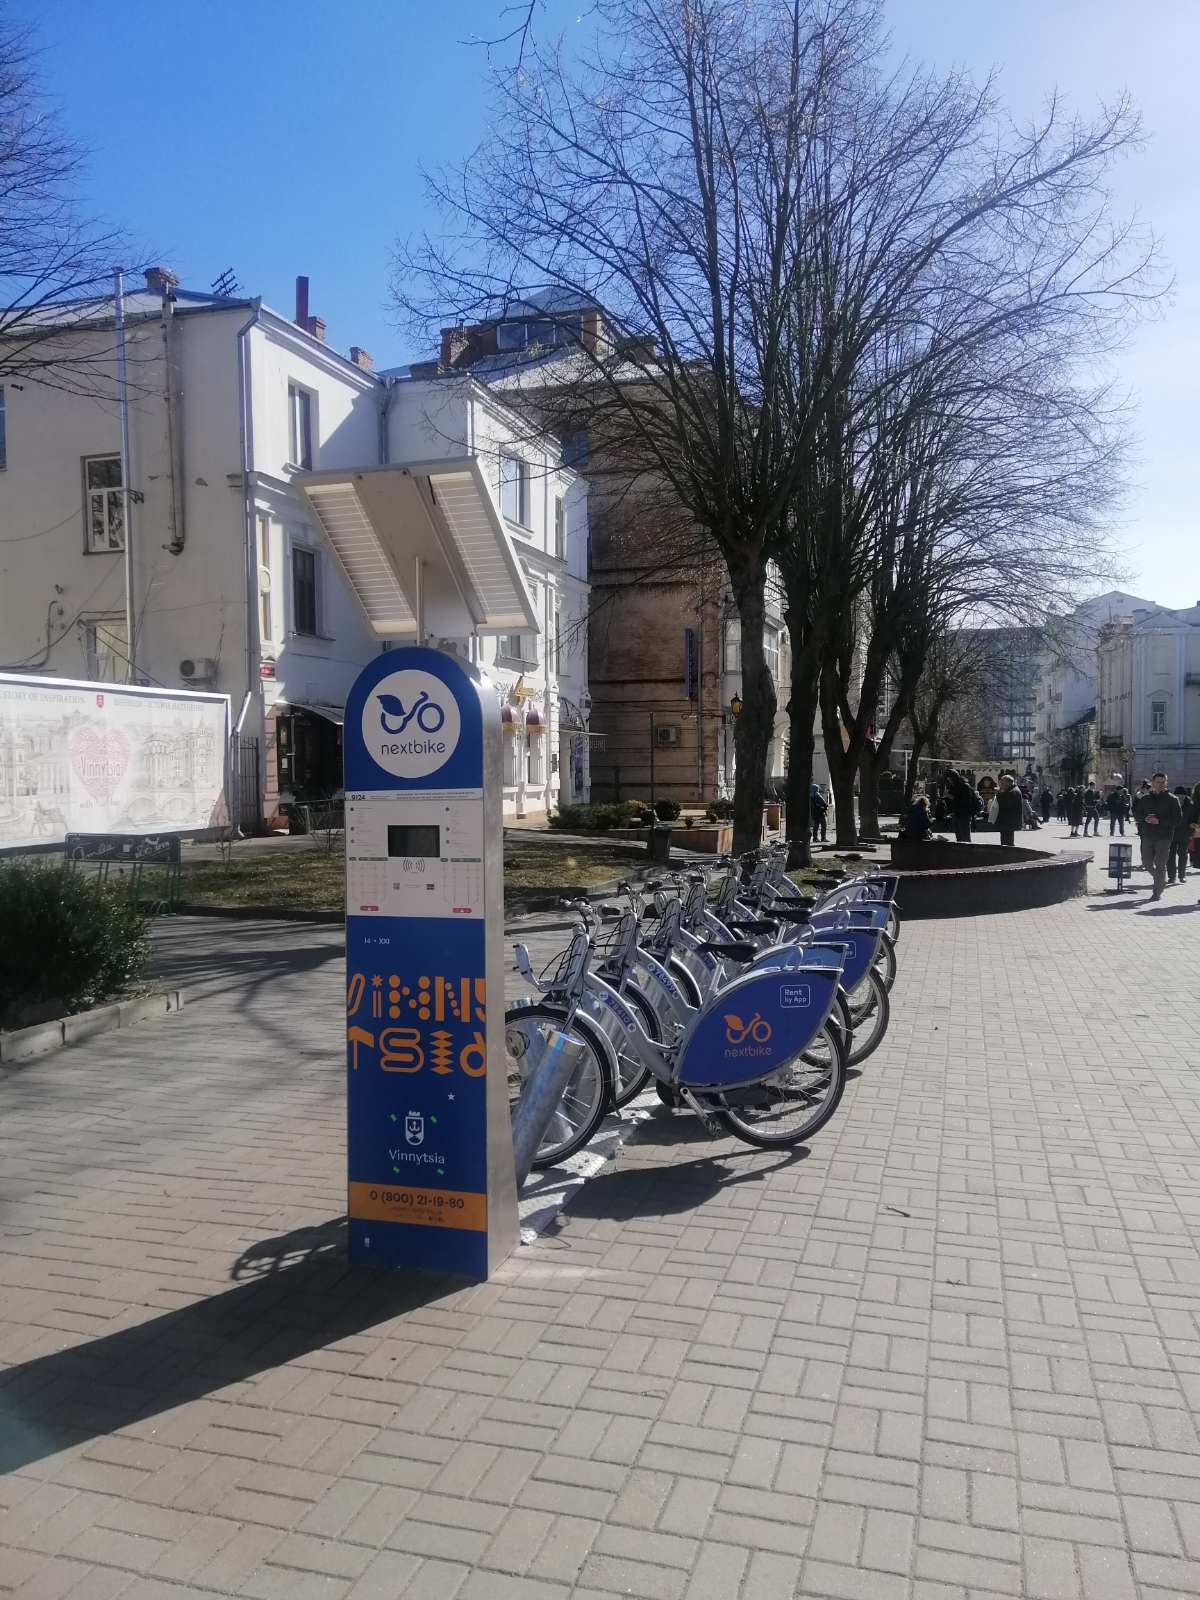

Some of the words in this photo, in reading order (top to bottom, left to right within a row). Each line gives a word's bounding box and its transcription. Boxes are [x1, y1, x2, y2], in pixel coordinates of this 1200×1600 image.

[381, 739, 446, 755] nextbike
[784, 996, 793, 1004] by
[793, 996, 807, 1004] App
[724, 1046, 772, 1057] nextbike
[388, 1149, 445, 1166] Vinnytsia
[369, 1190, 378, 1200] 0
[381, 1191, 414, 1206] (800)
[416, 1193, 465, 1209] 21-19-80
